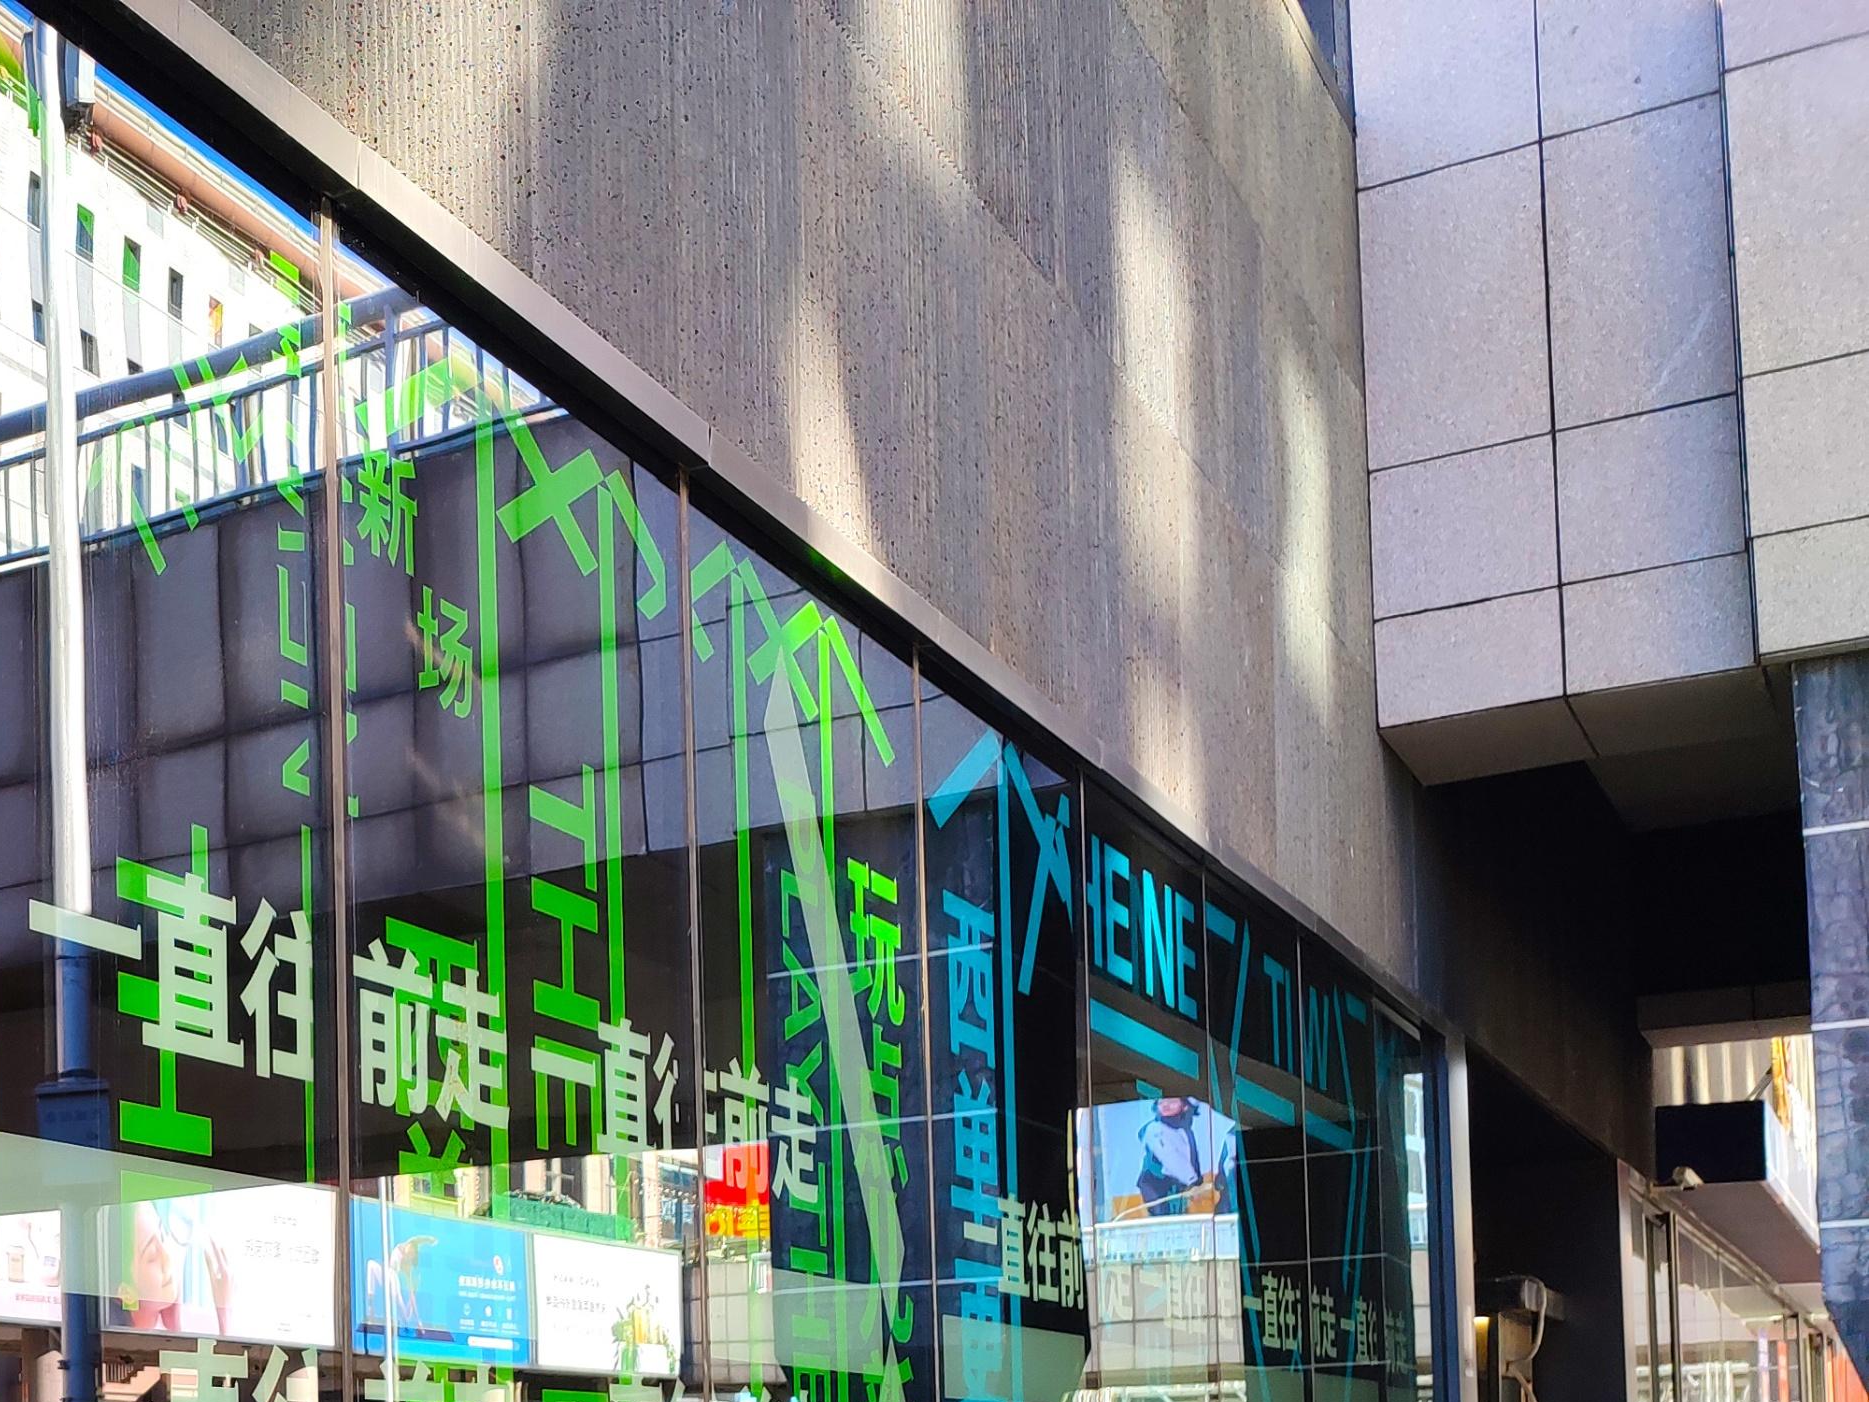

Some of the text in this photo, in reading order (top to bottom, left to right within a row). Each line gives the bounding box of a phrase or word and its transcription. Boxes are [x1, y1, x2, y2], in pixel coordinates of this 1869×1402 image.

[29, 873, 510, 1129] 一直往前走
